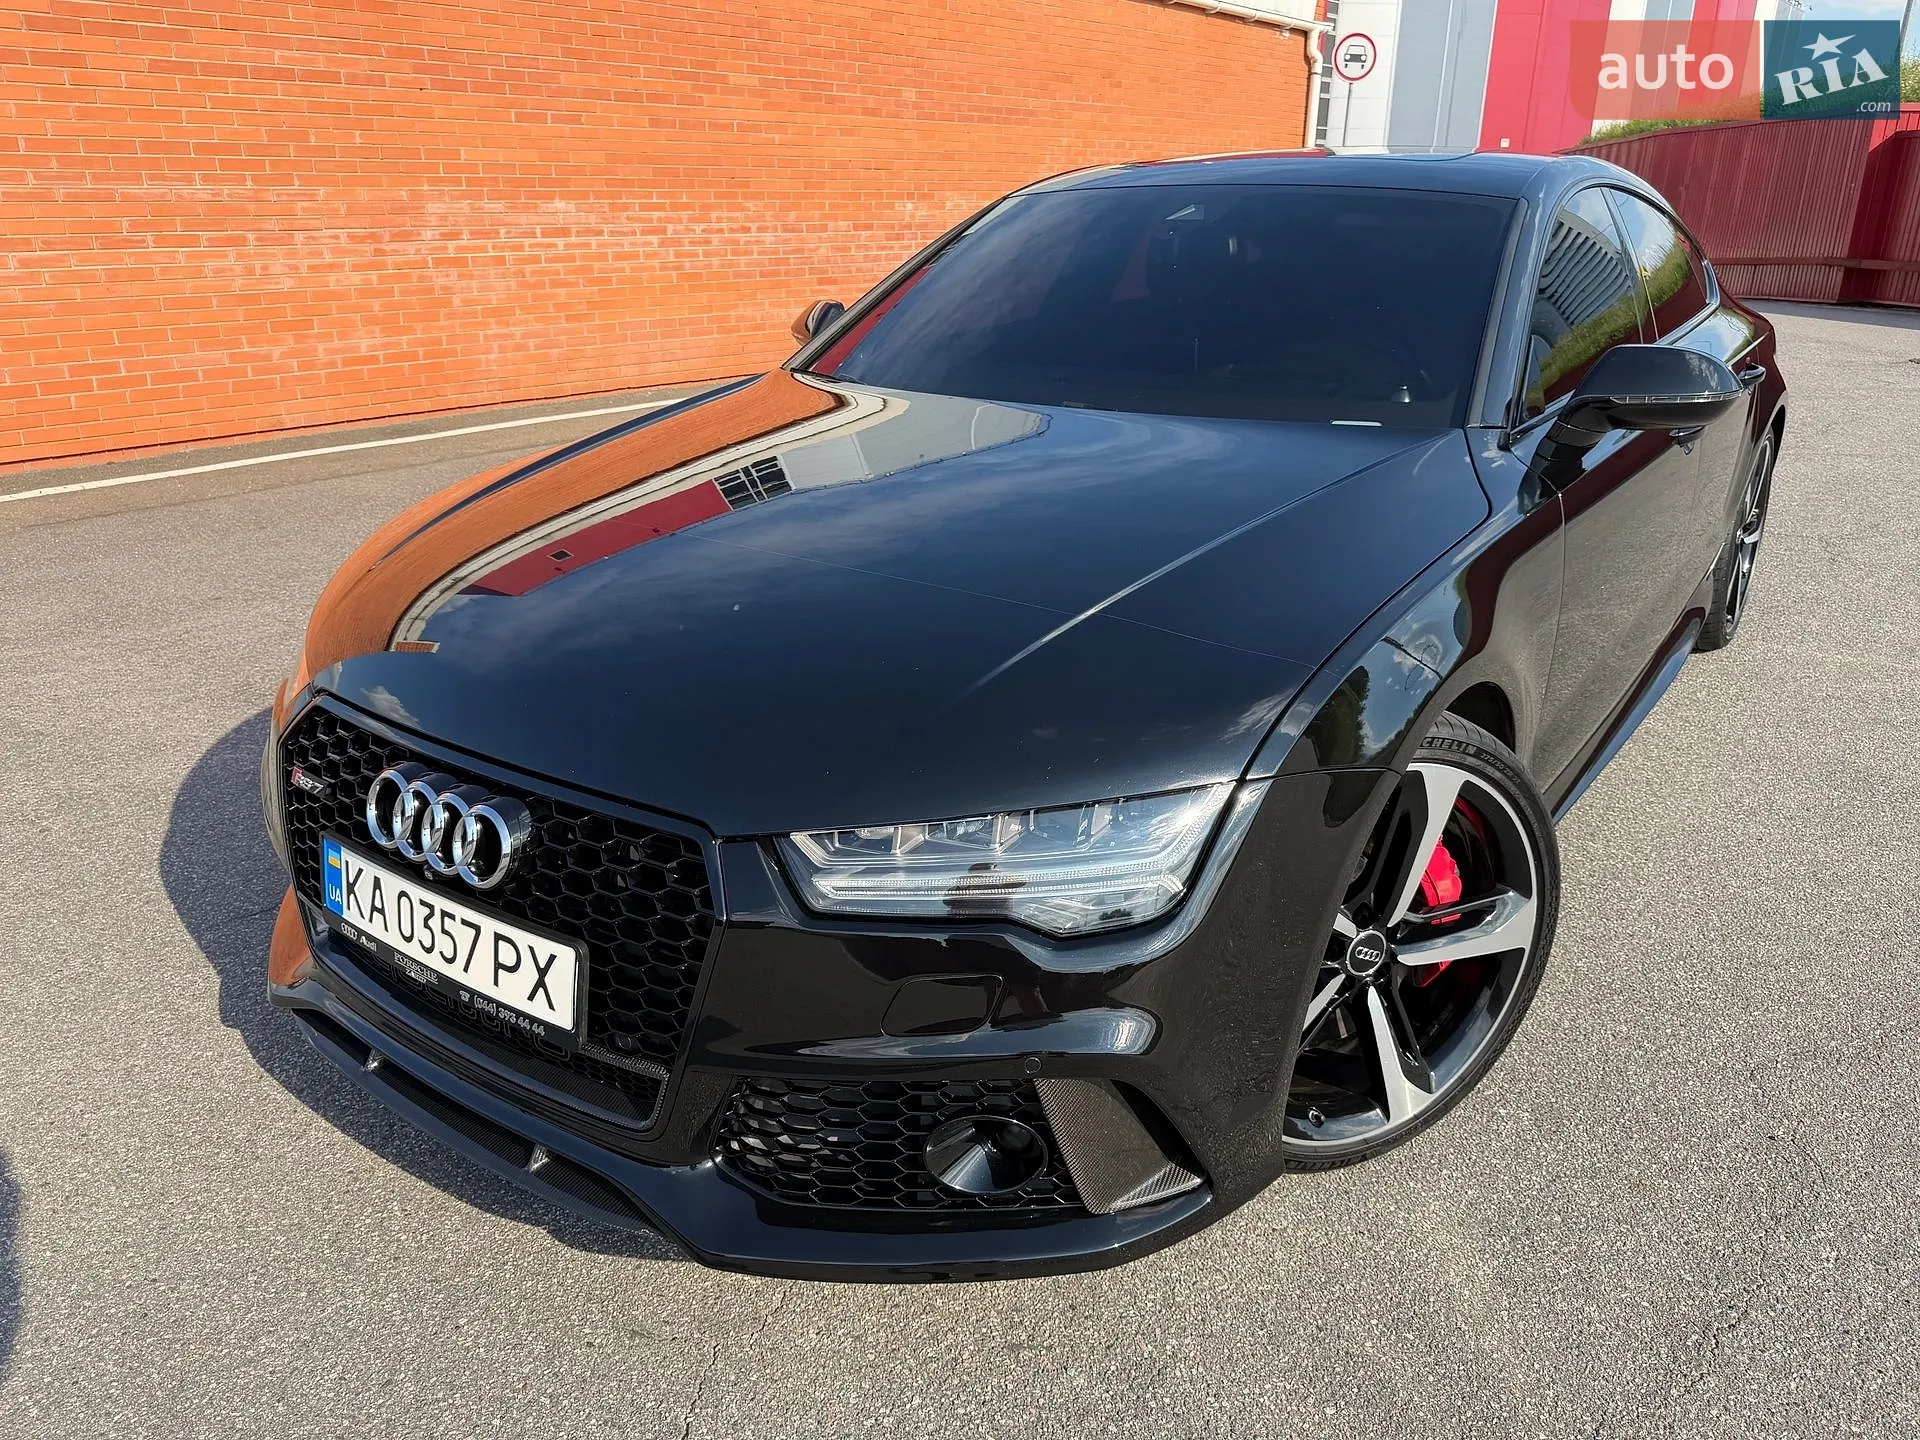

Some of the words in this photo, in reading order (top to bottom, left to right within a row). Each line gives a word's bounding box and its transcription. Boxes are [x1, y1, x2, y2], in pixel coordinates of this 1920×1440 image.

[1422, 738, 1477, 754] CHELIN
[328, 884, 342, 905] UA
[345, 860, 389, 933] KA
[397, 890, 482, 974] 0357
[493, 931, 557, 1012] PX
[360, 936, 377, 952] Audi
[394, 952, 438, 981] PORSCHE
